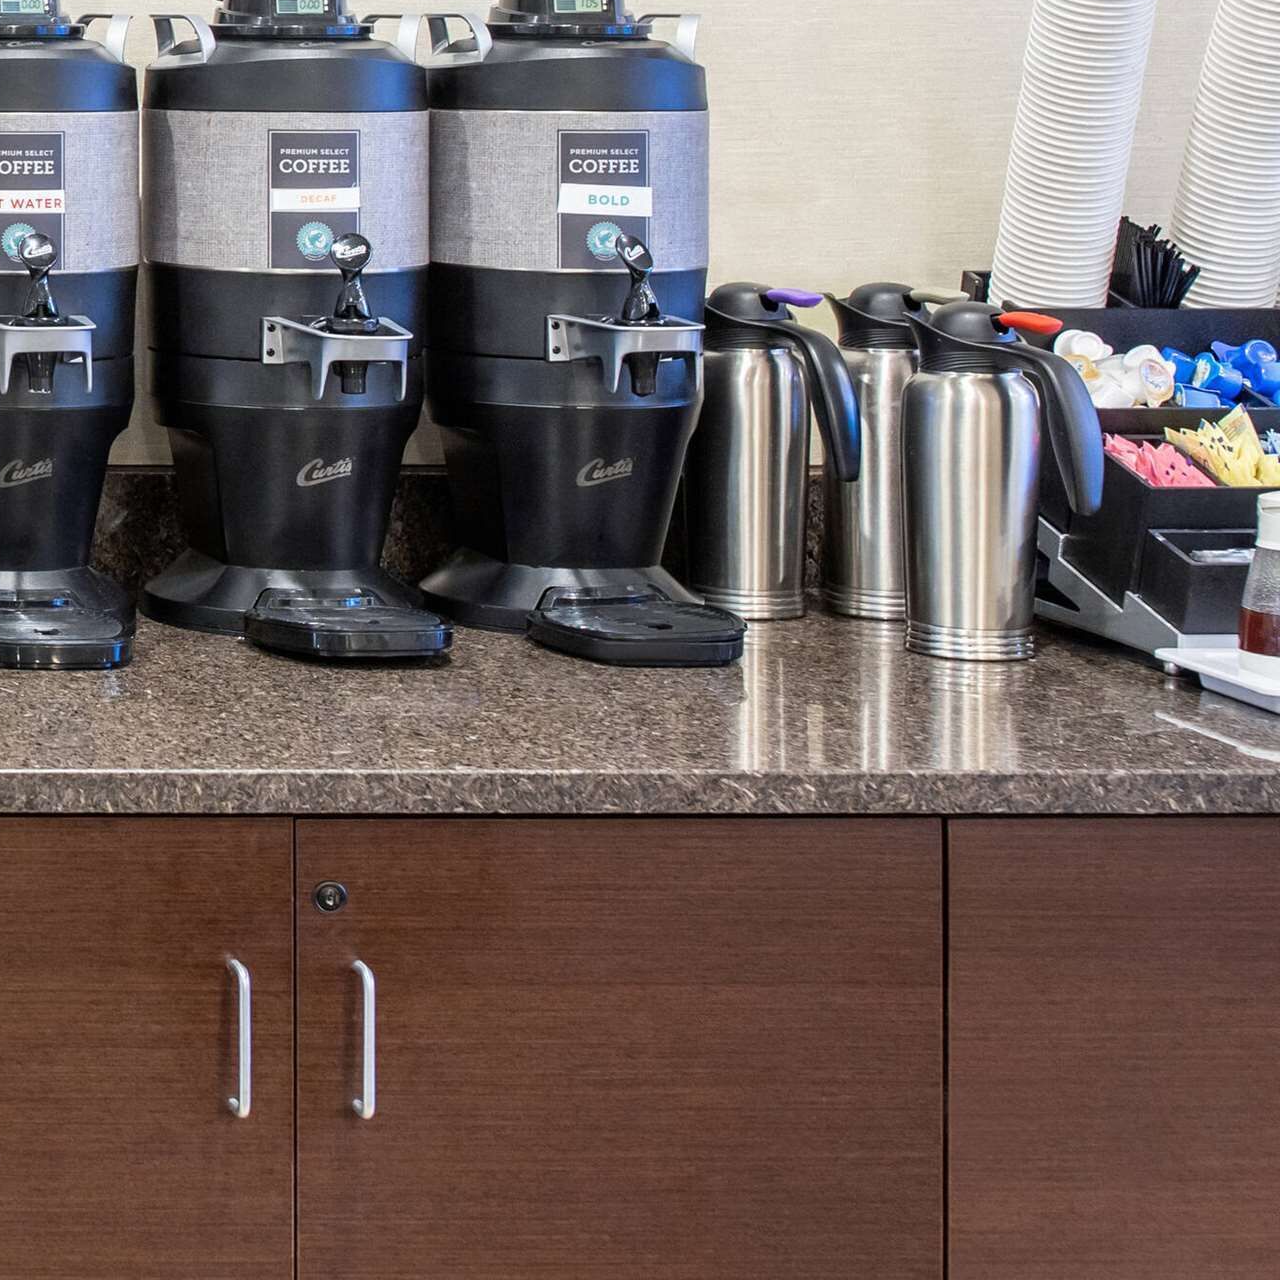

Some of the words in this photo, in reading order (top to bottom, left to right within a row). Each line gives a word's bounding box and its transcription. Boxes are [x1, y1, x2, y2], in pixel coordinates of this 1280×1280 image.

[24, 149, 54, 157] SELECT
[320, 147, 350, 155] SELECT
[610, 147, 639, 155] SELECT
[279, 159, 350, 174] COFFEE
[568, 159, 640, 174] COFFEE
[10, 199, 62, 209] WATER
[300, 194, 338, 204] DECAF
[588, 194, 630, 206] BOLD
[296, 457, 352, 487] Curtis
[576, 457, 633, 487] Curtis
